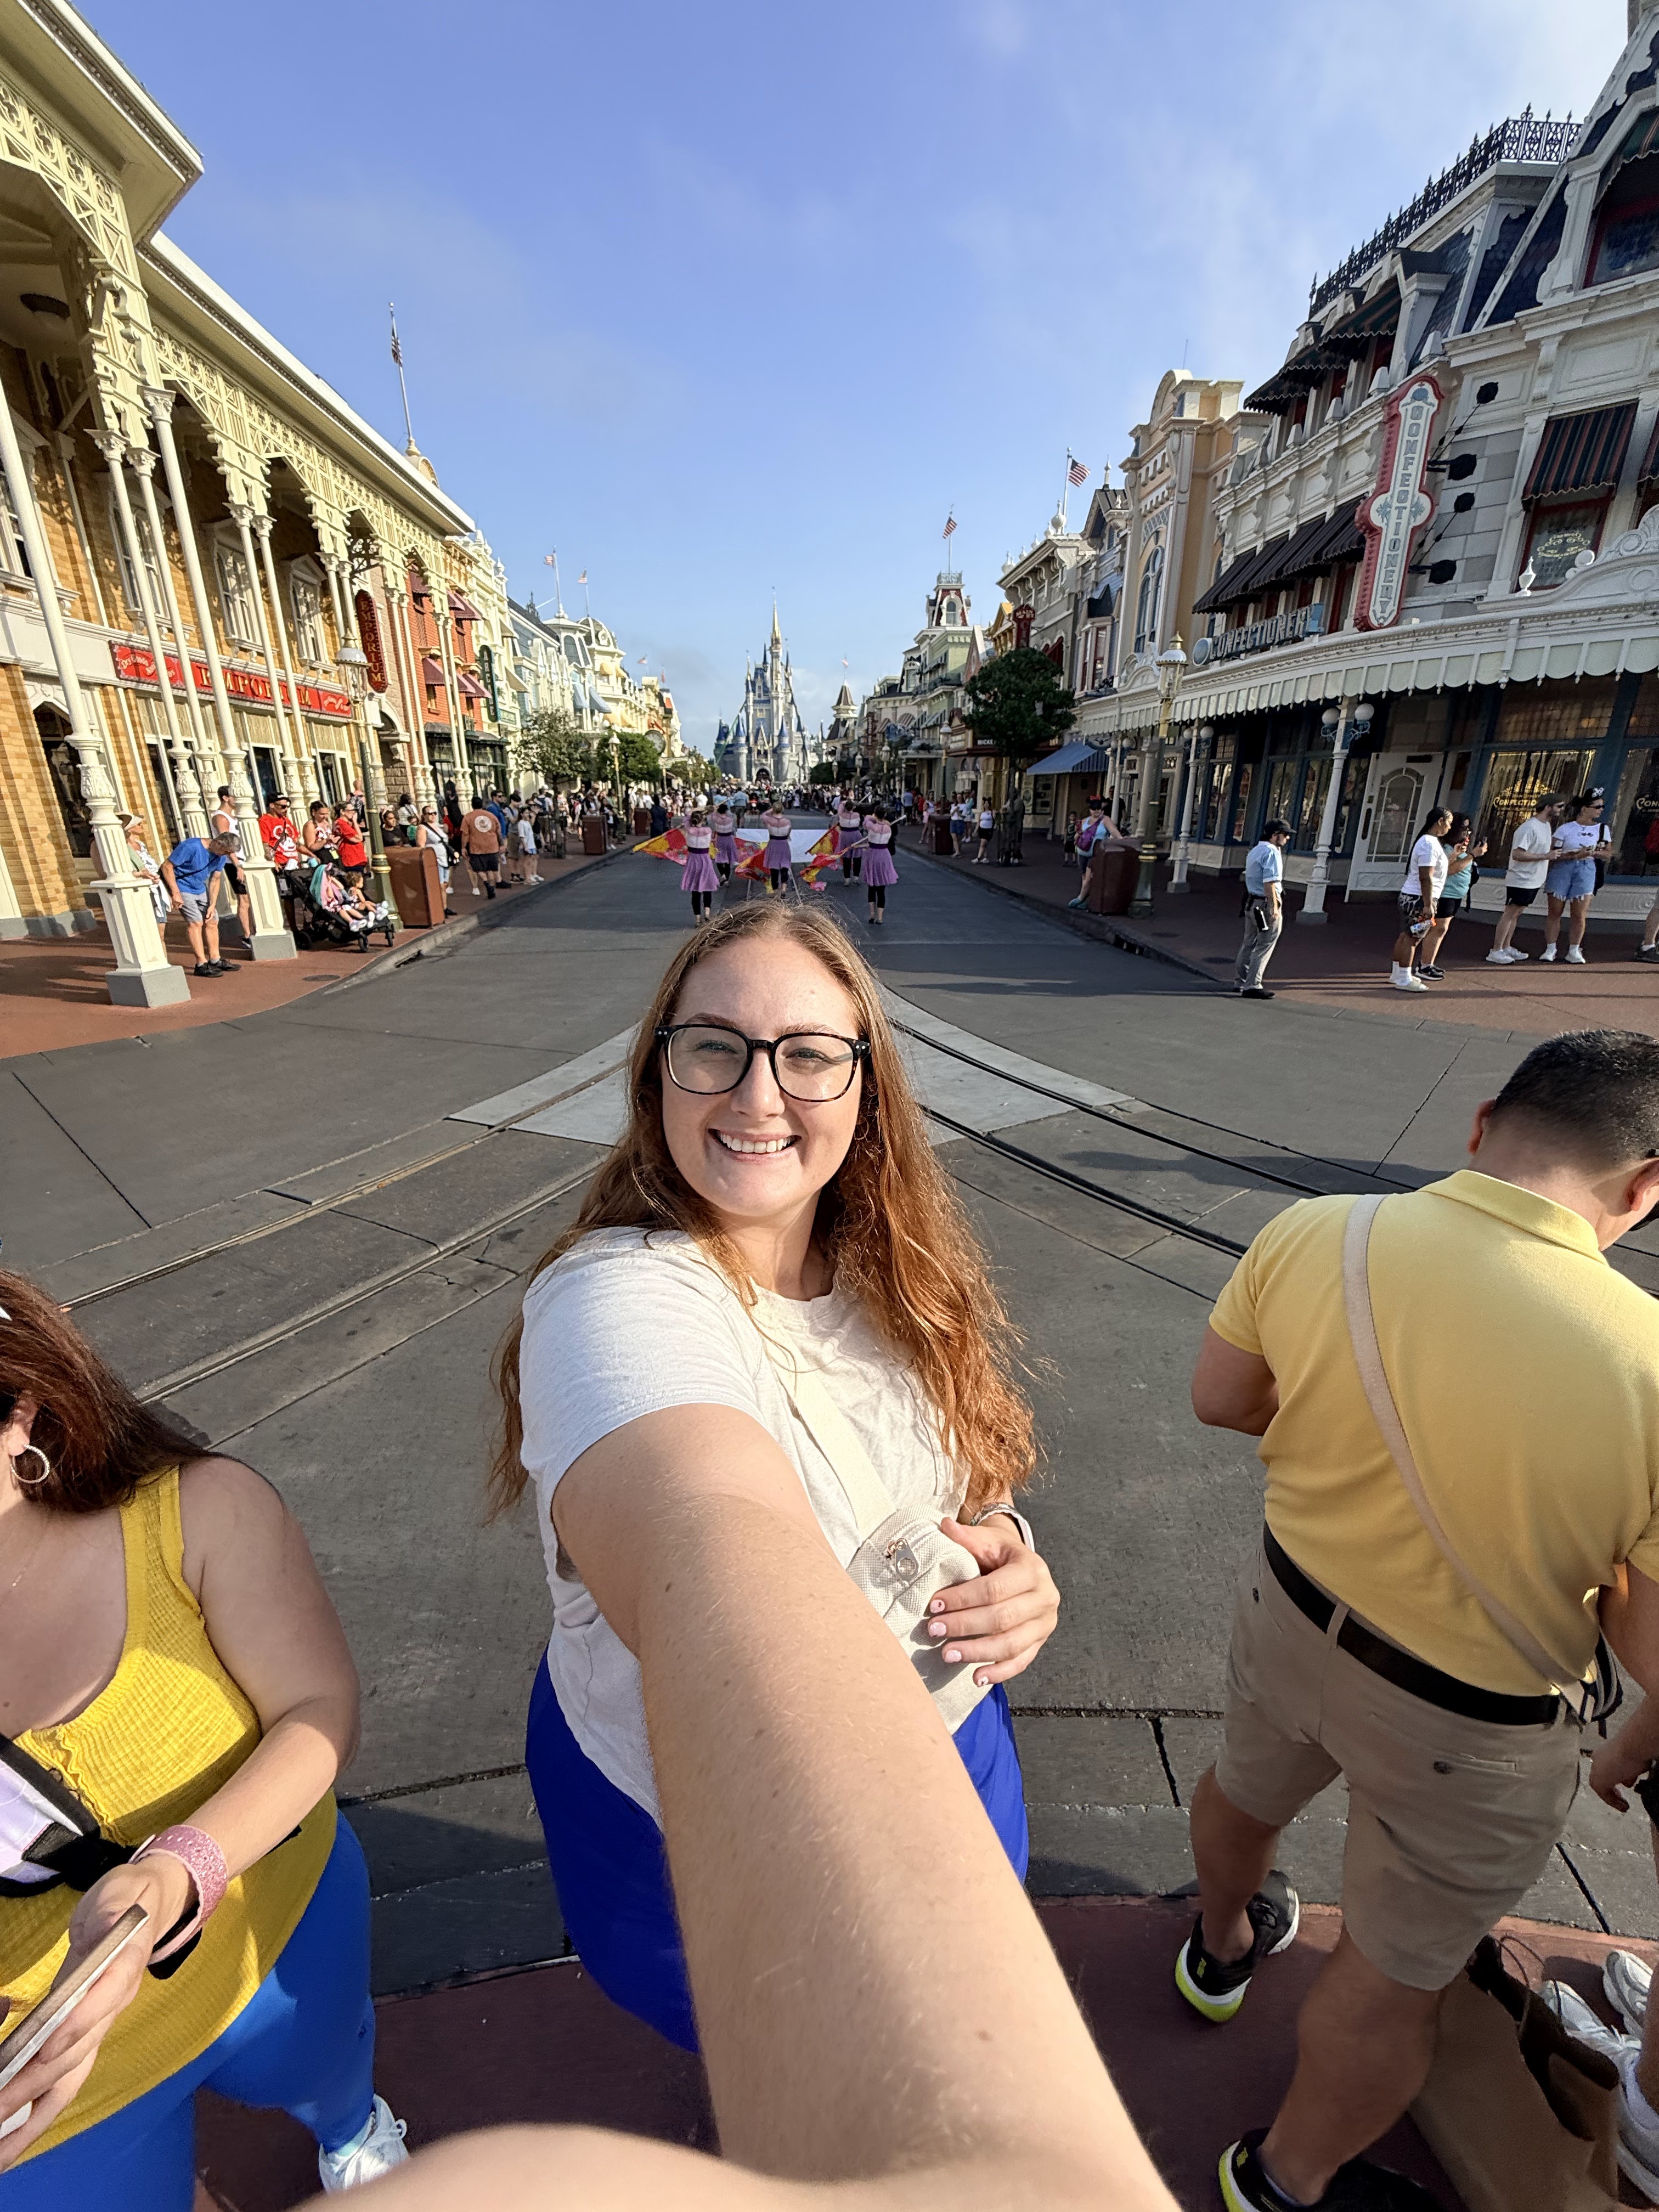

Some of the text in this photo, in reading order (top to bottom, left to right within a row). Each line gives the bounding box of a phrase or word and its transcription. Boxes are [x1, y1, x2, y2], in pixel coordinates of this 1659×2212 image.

[1379, 405, 1424, 614] CONFECTIONERY
[360, 601, 382, 681] EMPORIUM
[1493, 797, 1537, 808] CONFECTIO
[1636, 798, 1659, 810] CON
